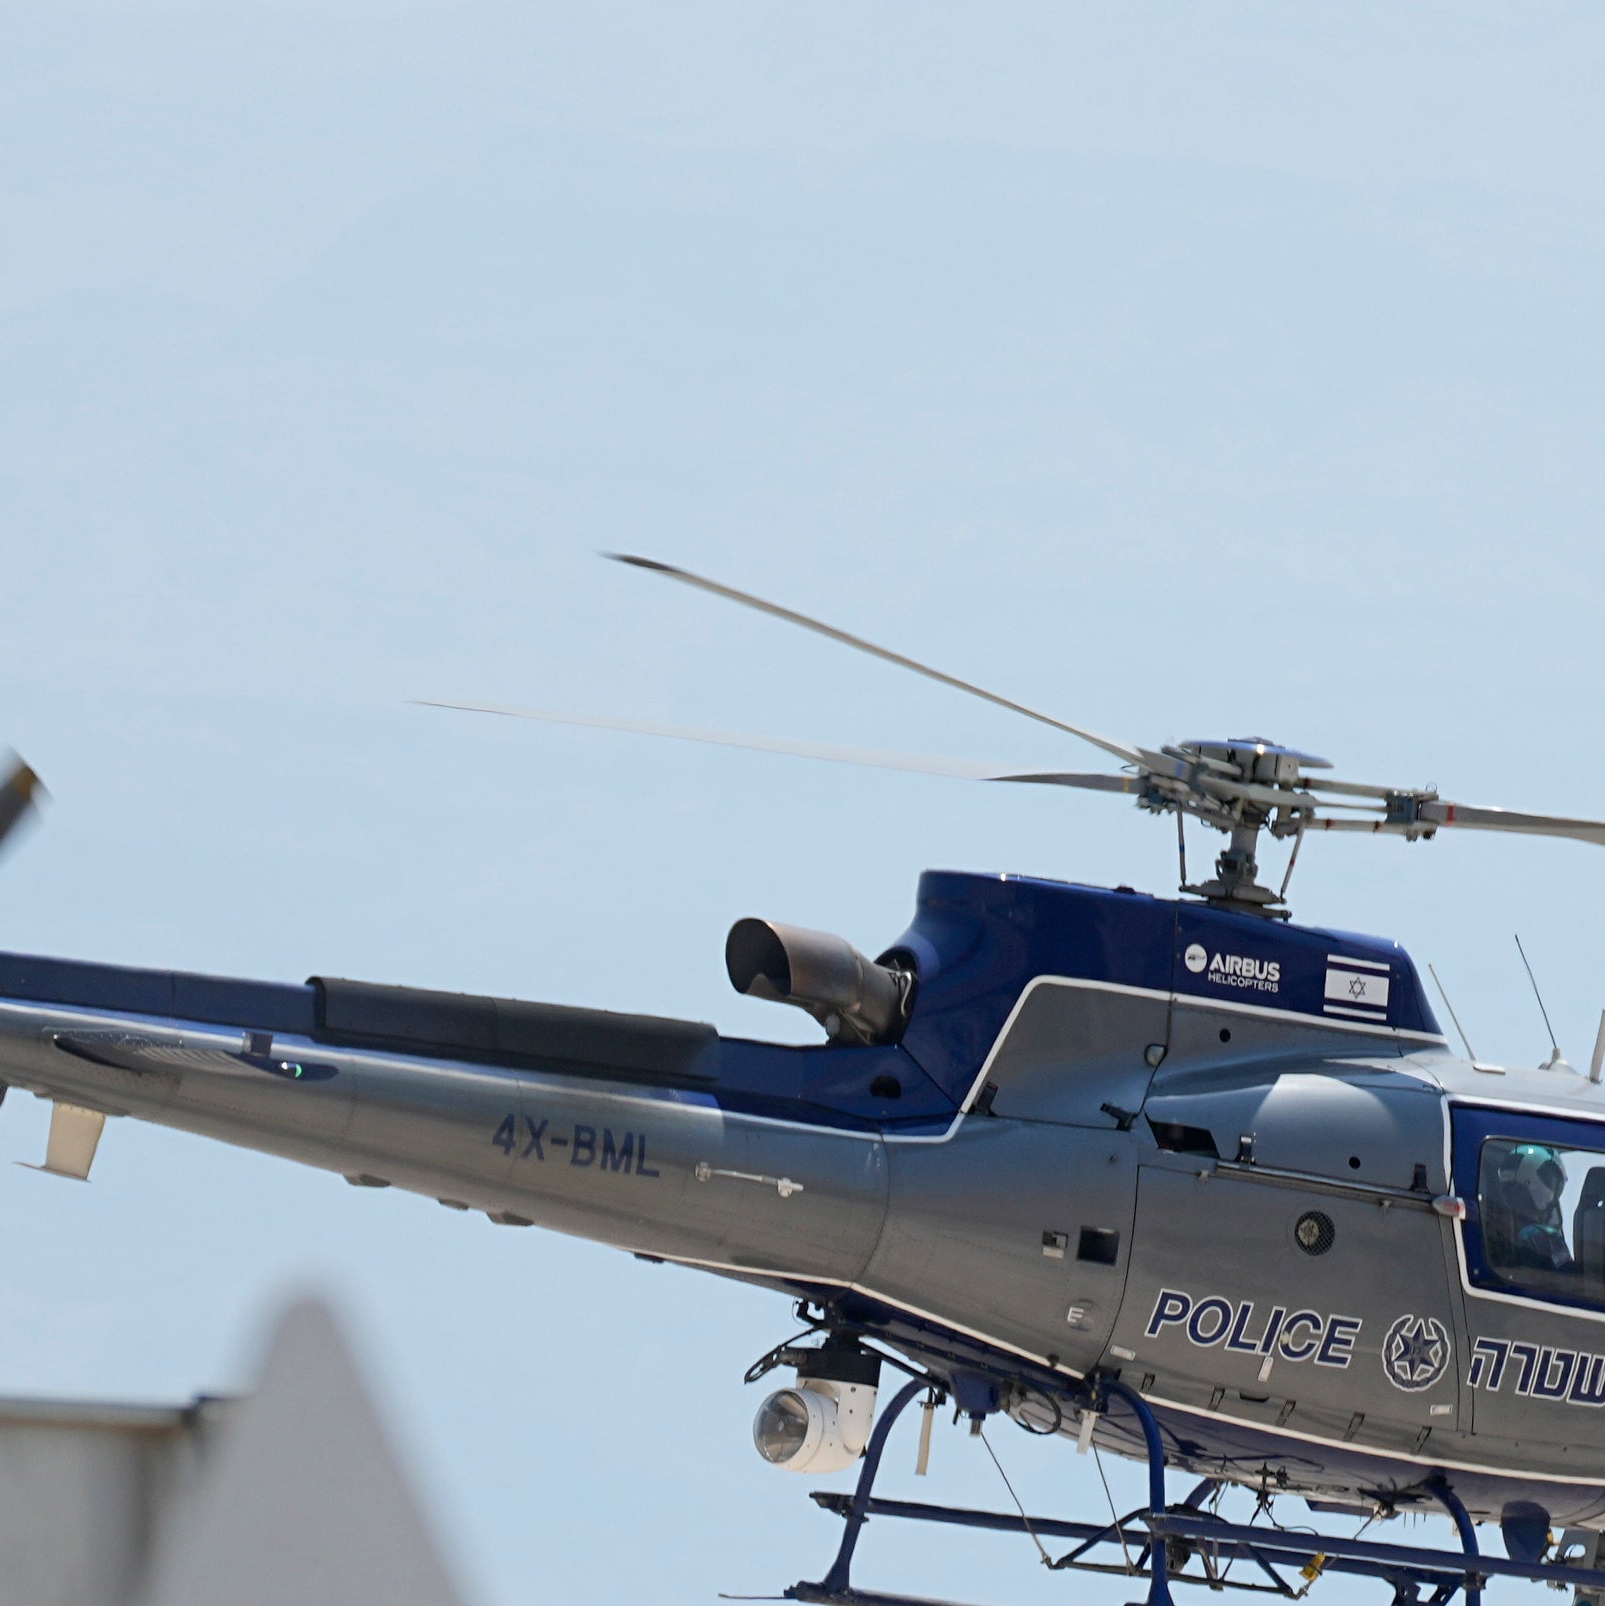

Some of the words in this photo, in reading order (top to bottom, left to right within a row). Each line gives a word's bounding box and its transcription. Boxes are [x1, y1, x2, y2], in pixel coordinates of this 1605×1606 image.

[1208, 971, 1279, 993] HELICOPTERS
[1209, 953, 1280, 981] AIRBUS
[492, 1113, 660, 1179] 4X-BML
[1144, 1288, 1363, 1368] POLICE
